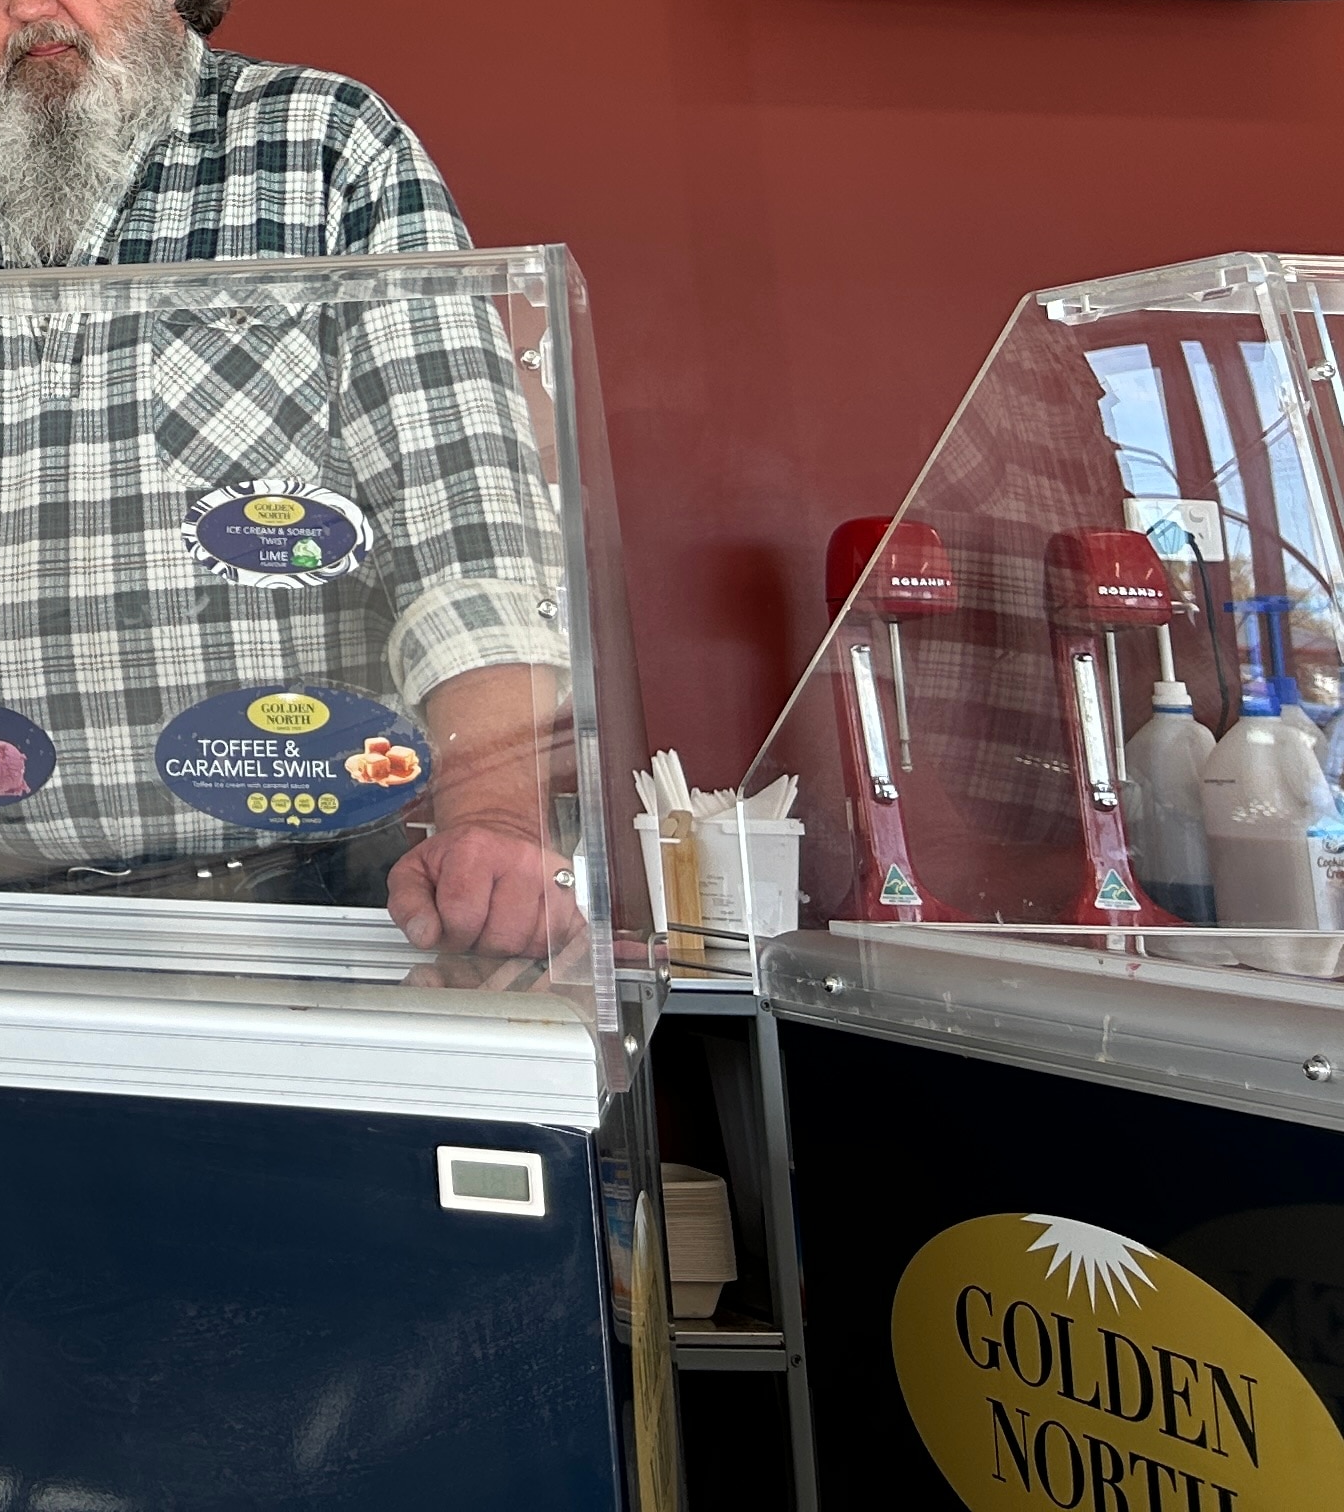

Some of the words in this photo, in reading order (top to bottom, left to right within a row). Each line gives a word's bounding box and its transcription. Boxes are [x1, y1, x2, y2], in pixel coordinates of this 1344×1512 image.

[254, 503, 295, 512] GOLDEN
[258, 511, 291, 520] NORTH
[226, 526, 241, 534] ICE
[243, 526, 276, 535] CREAM
[277, 527, 285, 535] &
[286, 528, 323, 537] SORBET
[261, 537, 288, 546] TWIST
[259, 551, 289, 562] LIME
[261, 703, 315, 714] GOLDEN
[266, 714, 311, 725] NORTH
[198, 739, 278, 758] TOFFEE
[284, 739, 300, 757] &
[165, 759, 268, 778] CARAMEL
[272, 759, 337, 778] SWIRL
[955, 1285, 1259, 1470] GOLDEN
